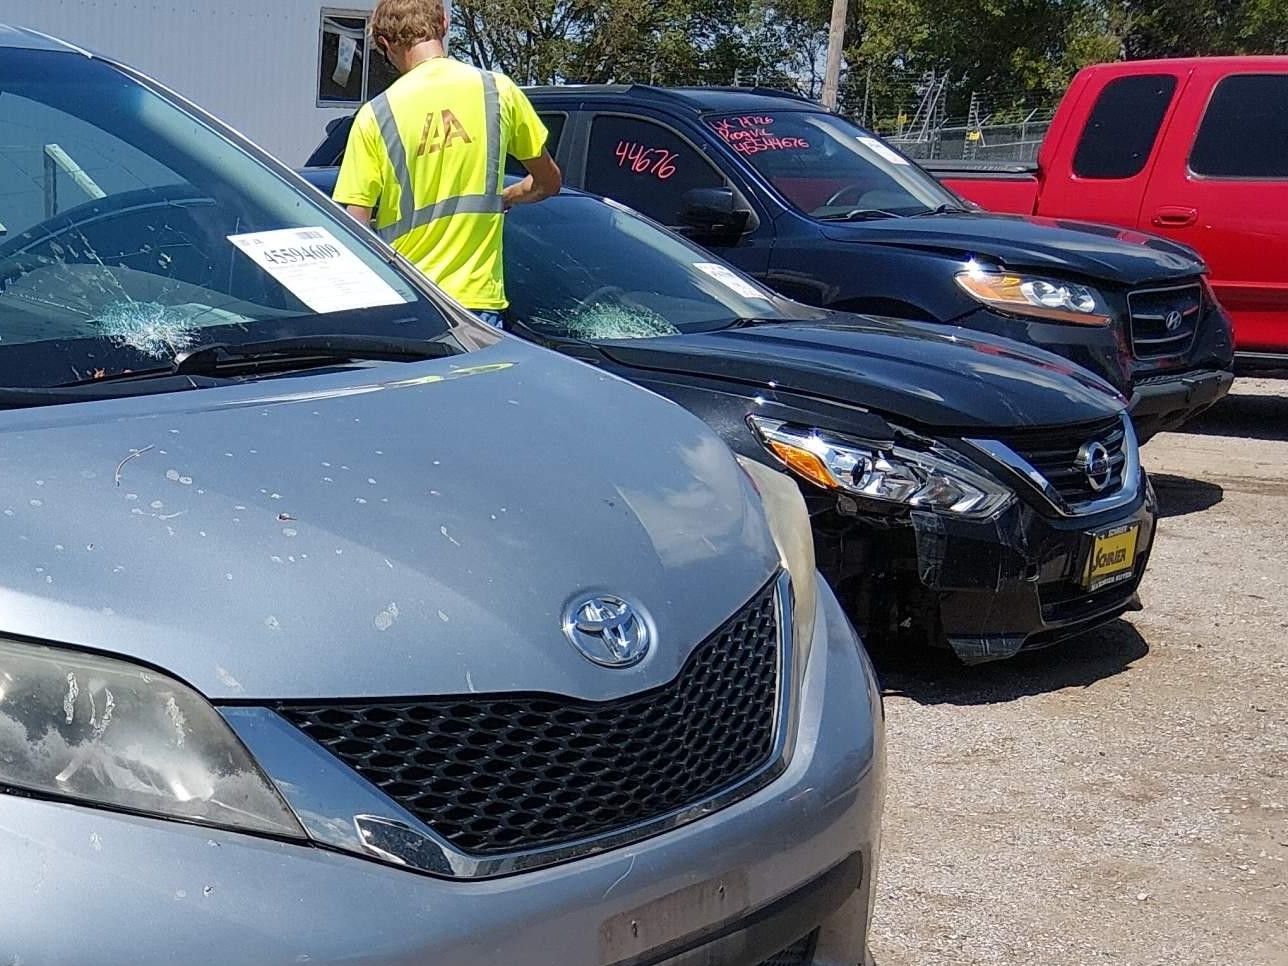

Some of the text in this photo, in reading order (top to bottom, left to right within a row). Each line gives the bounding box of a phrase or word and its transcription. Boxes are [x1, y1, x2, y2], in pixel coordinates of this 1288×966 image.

[733, 136, 810, 155] 45544676
[615, 140, 680, 178] 44676
[263, 243, 341, 265] 45594609
